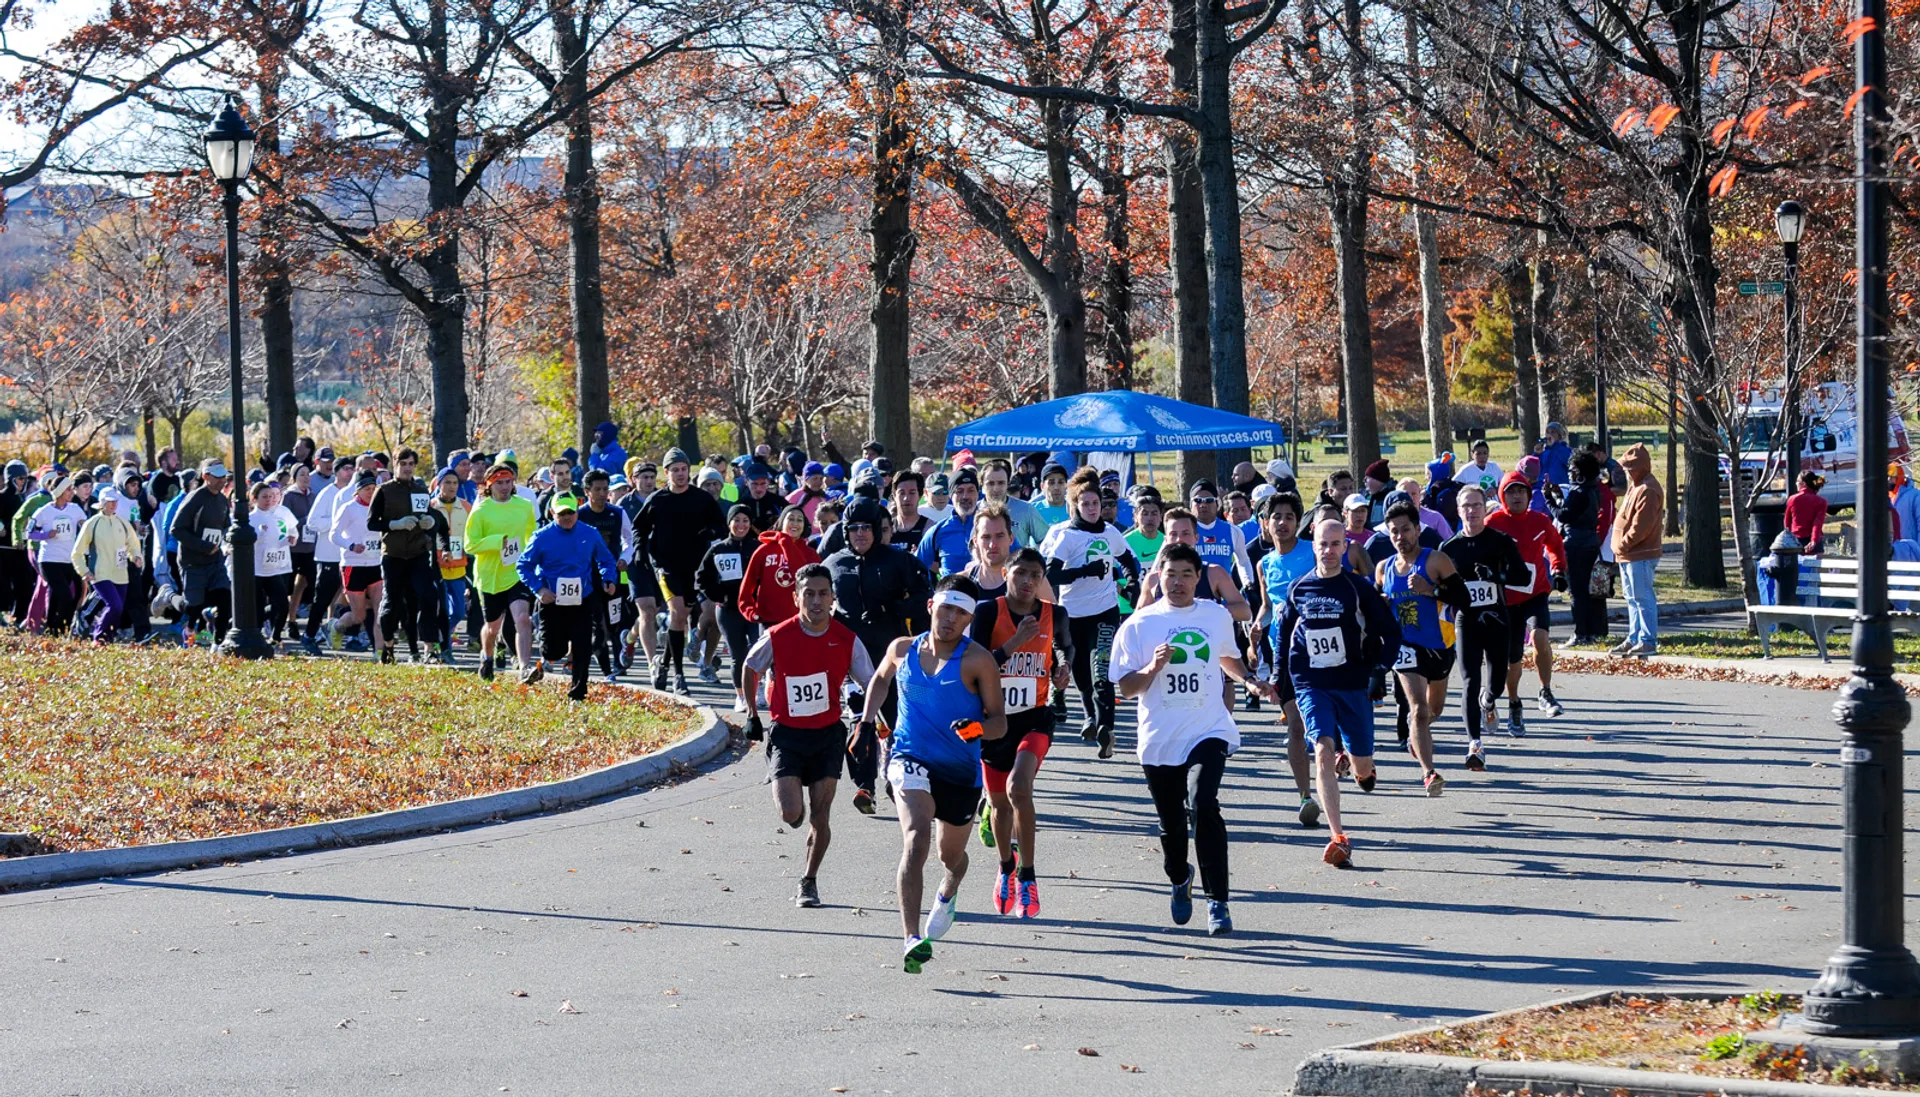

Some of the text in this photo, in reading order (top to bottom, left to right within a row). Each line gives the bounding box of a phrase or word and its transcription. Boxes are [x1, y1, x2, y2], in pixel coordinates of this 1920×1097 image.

[1155, 429, 1273, 447] srichinmoyraces.org
[503, 545, 519, 558] 284
[719, 558, 737, 572] 697
[560, 583, 580, 597] 364
[1469, 587, 1493, 603] 384
[1311, 636, 1339, 655] 394
[1166, 673, 1199, 694] 386
[792, 682, 824, 703] 392
